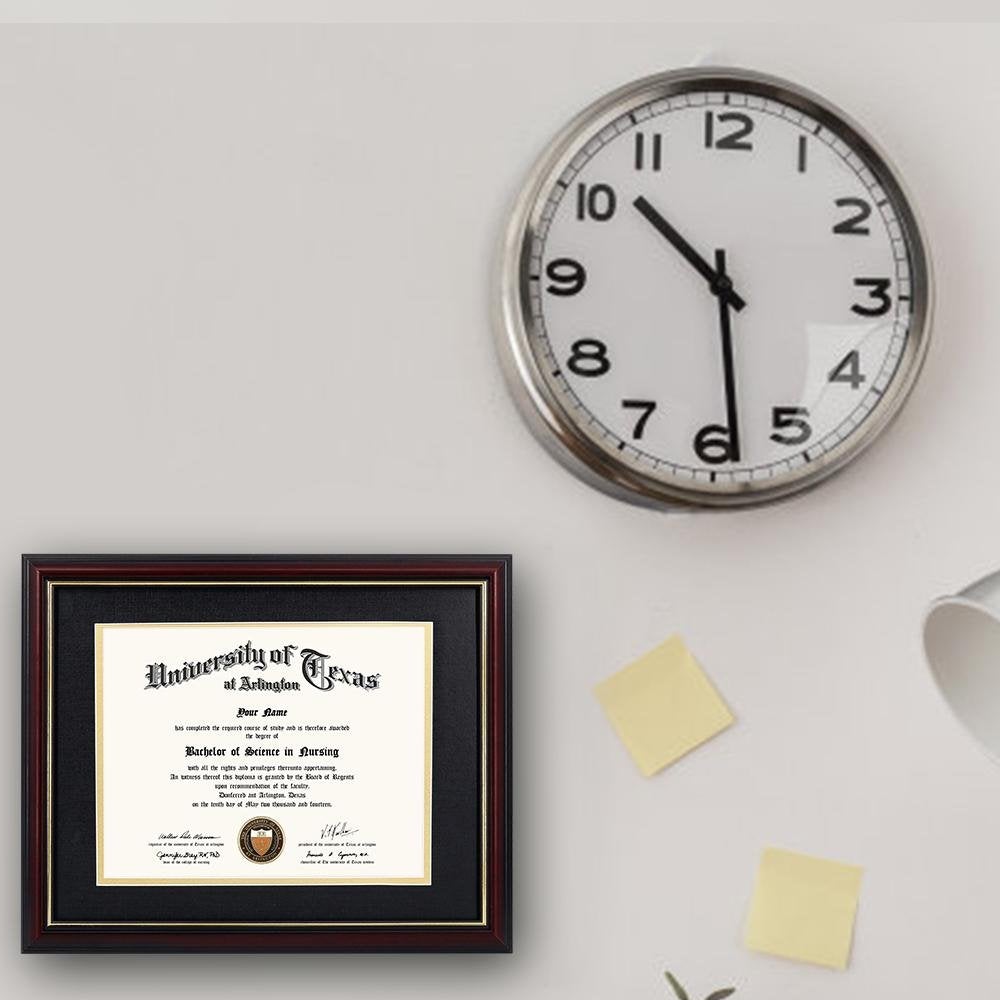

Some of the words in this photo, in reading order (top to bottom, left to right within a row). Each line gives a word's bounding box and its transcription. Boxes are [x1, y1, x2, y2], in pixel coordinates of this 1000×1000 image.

[704, 111, 754, 151] 12
[635, 132, 661, 171] 11
[798, 135, 807, 173] 1
[576, 182, 616, 222] 10
[832, 198, 871, 236] 2
[545, 258, 587, 296] 9
[850, 277, 892, 317] 3
[566, 338, 611, 378] 8
[828, 349, 866, 390] 4
[621, 400, 657, 439] 7
[770, 407, 812, 445] 5
[693, 424, 731, 465] 6
[144, 640, 267, 690] University
[269, 644, 298, 666] of
[300, 648, 381, 691] Texas
[224, 678, 236, 690] at
[238, 676, 300, 693] Arlington
[236, 708, 258, 718] Your
[262, 708, 288, 718] Name
[185, 746, 226, 757] Bachelor
[231, 747, 240, 756] of
[245, 747, 280, 756] Science
[285, 747, 293, 756] in
[298, 747, 339, 758] Nursing
